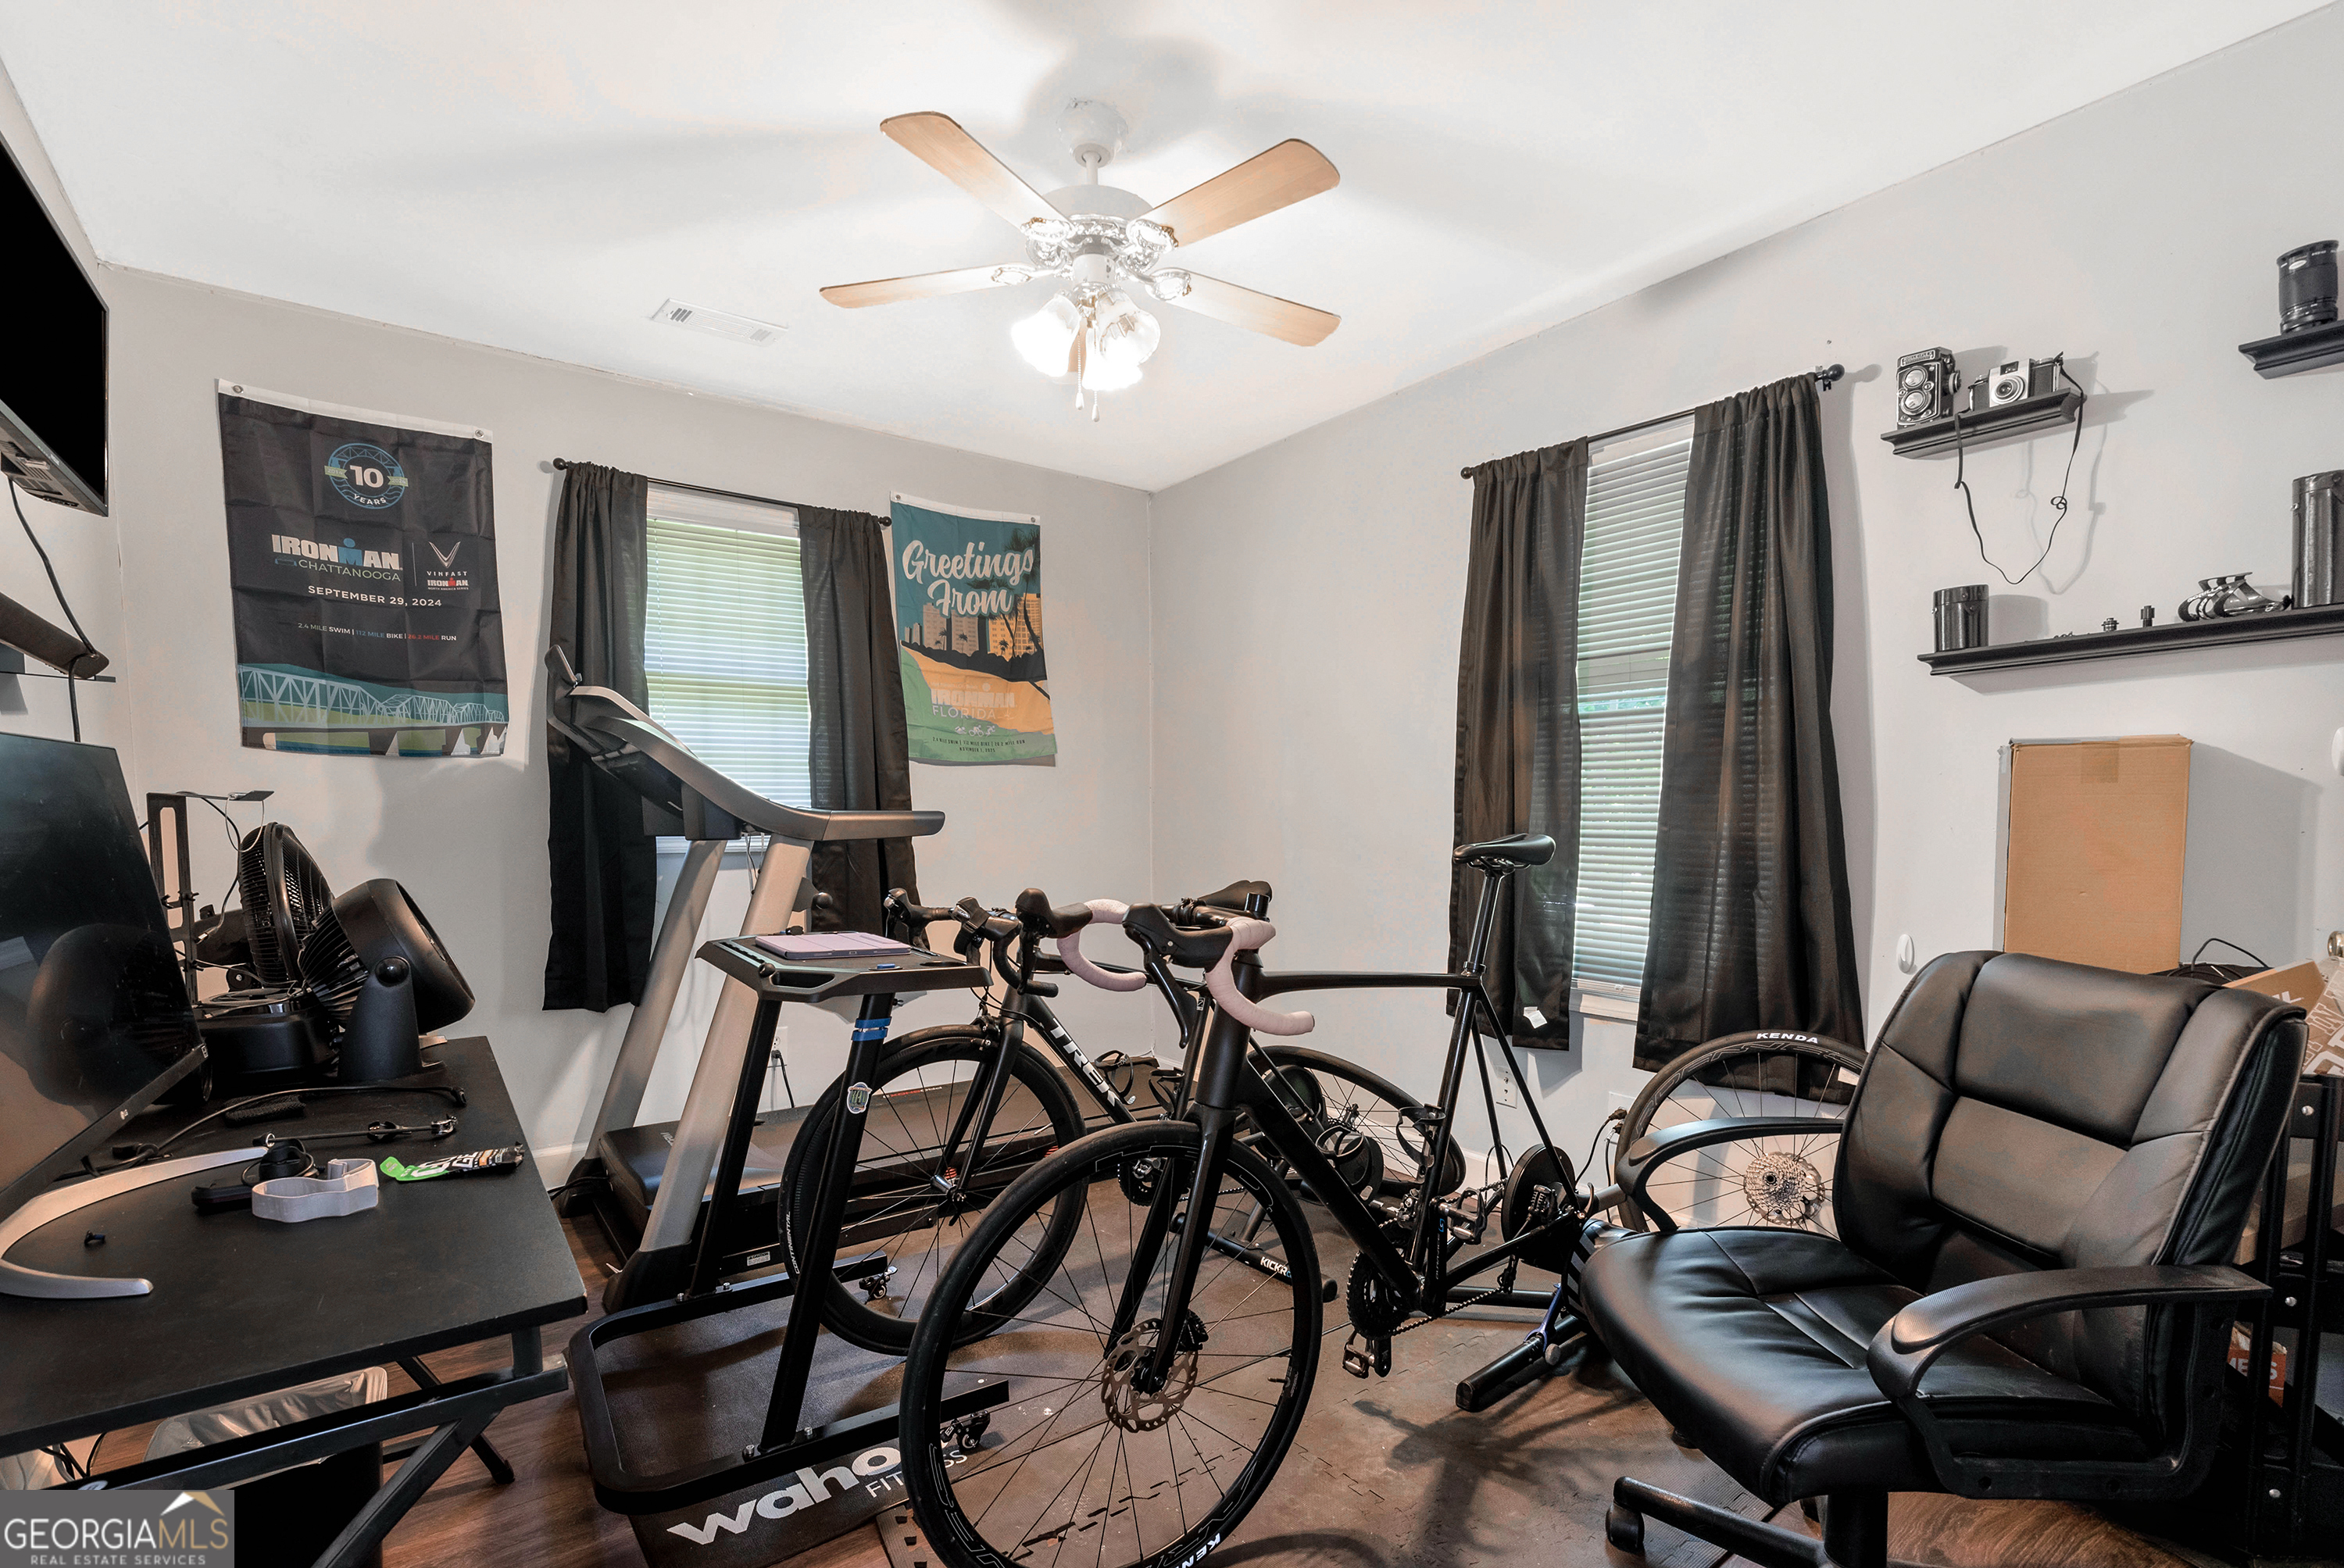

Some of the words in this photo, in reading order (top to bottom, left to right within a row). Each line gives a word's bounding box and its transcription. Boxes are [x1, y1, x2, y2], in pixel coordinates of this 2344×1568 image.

[349, 465, 384, 488] 10
[353, 494, 387, 505] YEARS
[271, 534, 400, 570] IRONMAN
[902, 540, 1034, 586] Greetings
[298, 559, 402, 582] CHATTANOOGA
[427, 577, 469, 587] IRONMAN
[308, 585, 385, 604] SEPTEMBER
[390, 596, 408, 606] 29,
[927, 579, 1013, 616] From
[310, 623, 327, 632] MILE
[328, 626, 351, 634] SWIM
[931, 683, 1015, 709] IRONMAN
[932, 705, 996, 720] FLORIDA
[1756, 1032, 1819, 1044] KENDA
[1050, 1017, 1122, 1107] TREK
[786, 1211, 800, 1274] CONTINENTAL
[1260, 1256, 1288, 1277] KICKR
[866, 1450, 968, 1498] FITSS
[666, 1439, 948, 1545] waho
[1175, 1533, 1220, 1568] KEN
